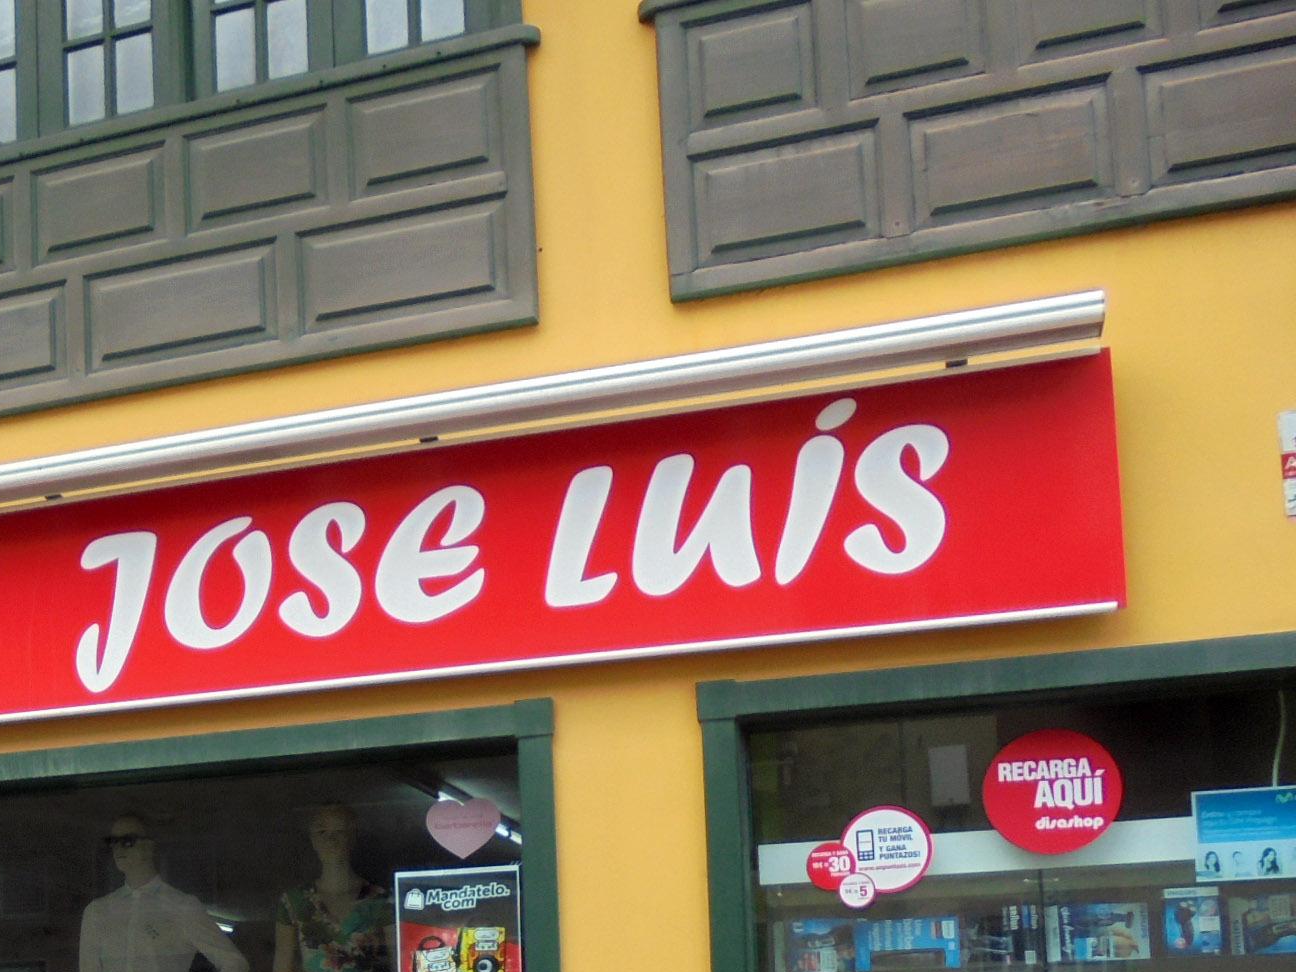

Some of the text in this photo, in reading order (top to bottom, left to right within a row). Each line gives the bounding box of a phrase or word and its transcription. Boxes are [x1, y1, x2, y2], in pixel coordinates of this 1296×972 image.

[997, 757, 1092, 782] RECARGA
[1033, 768, 1105, 810] AQUÍ
[1035, 815, 1104, 830] disashop
[878, 826, 913, 836] RECARGA
[886, 844, 907, 852] GANA
[828, 856, 851, 873] 30
[859, 885, 868, 897] 5
